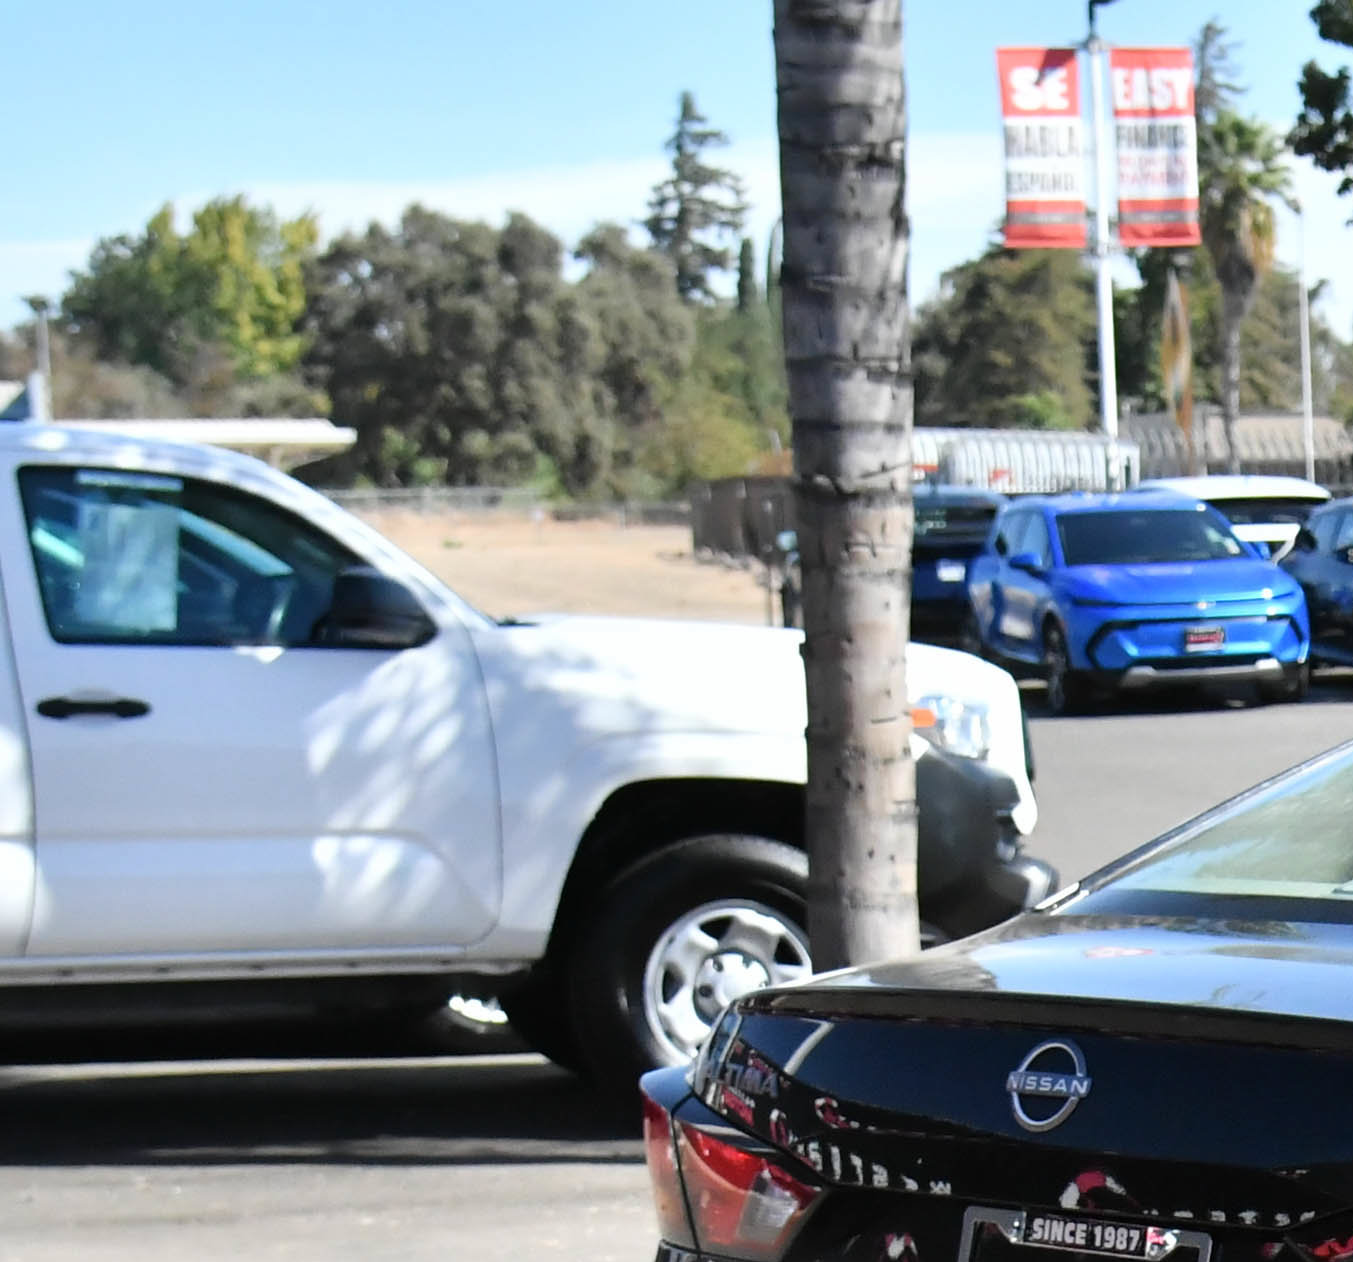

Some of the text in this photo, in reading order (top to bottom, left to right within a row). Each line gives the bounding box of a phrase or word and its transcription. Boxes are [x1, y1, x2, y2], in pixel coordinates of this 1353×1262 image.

[1113, 68, 1192, 110] EASY
[1008, 1073, 1088, 1095] NISSAN
[1031, 1218, 1141, 1252] SINCE 1987
